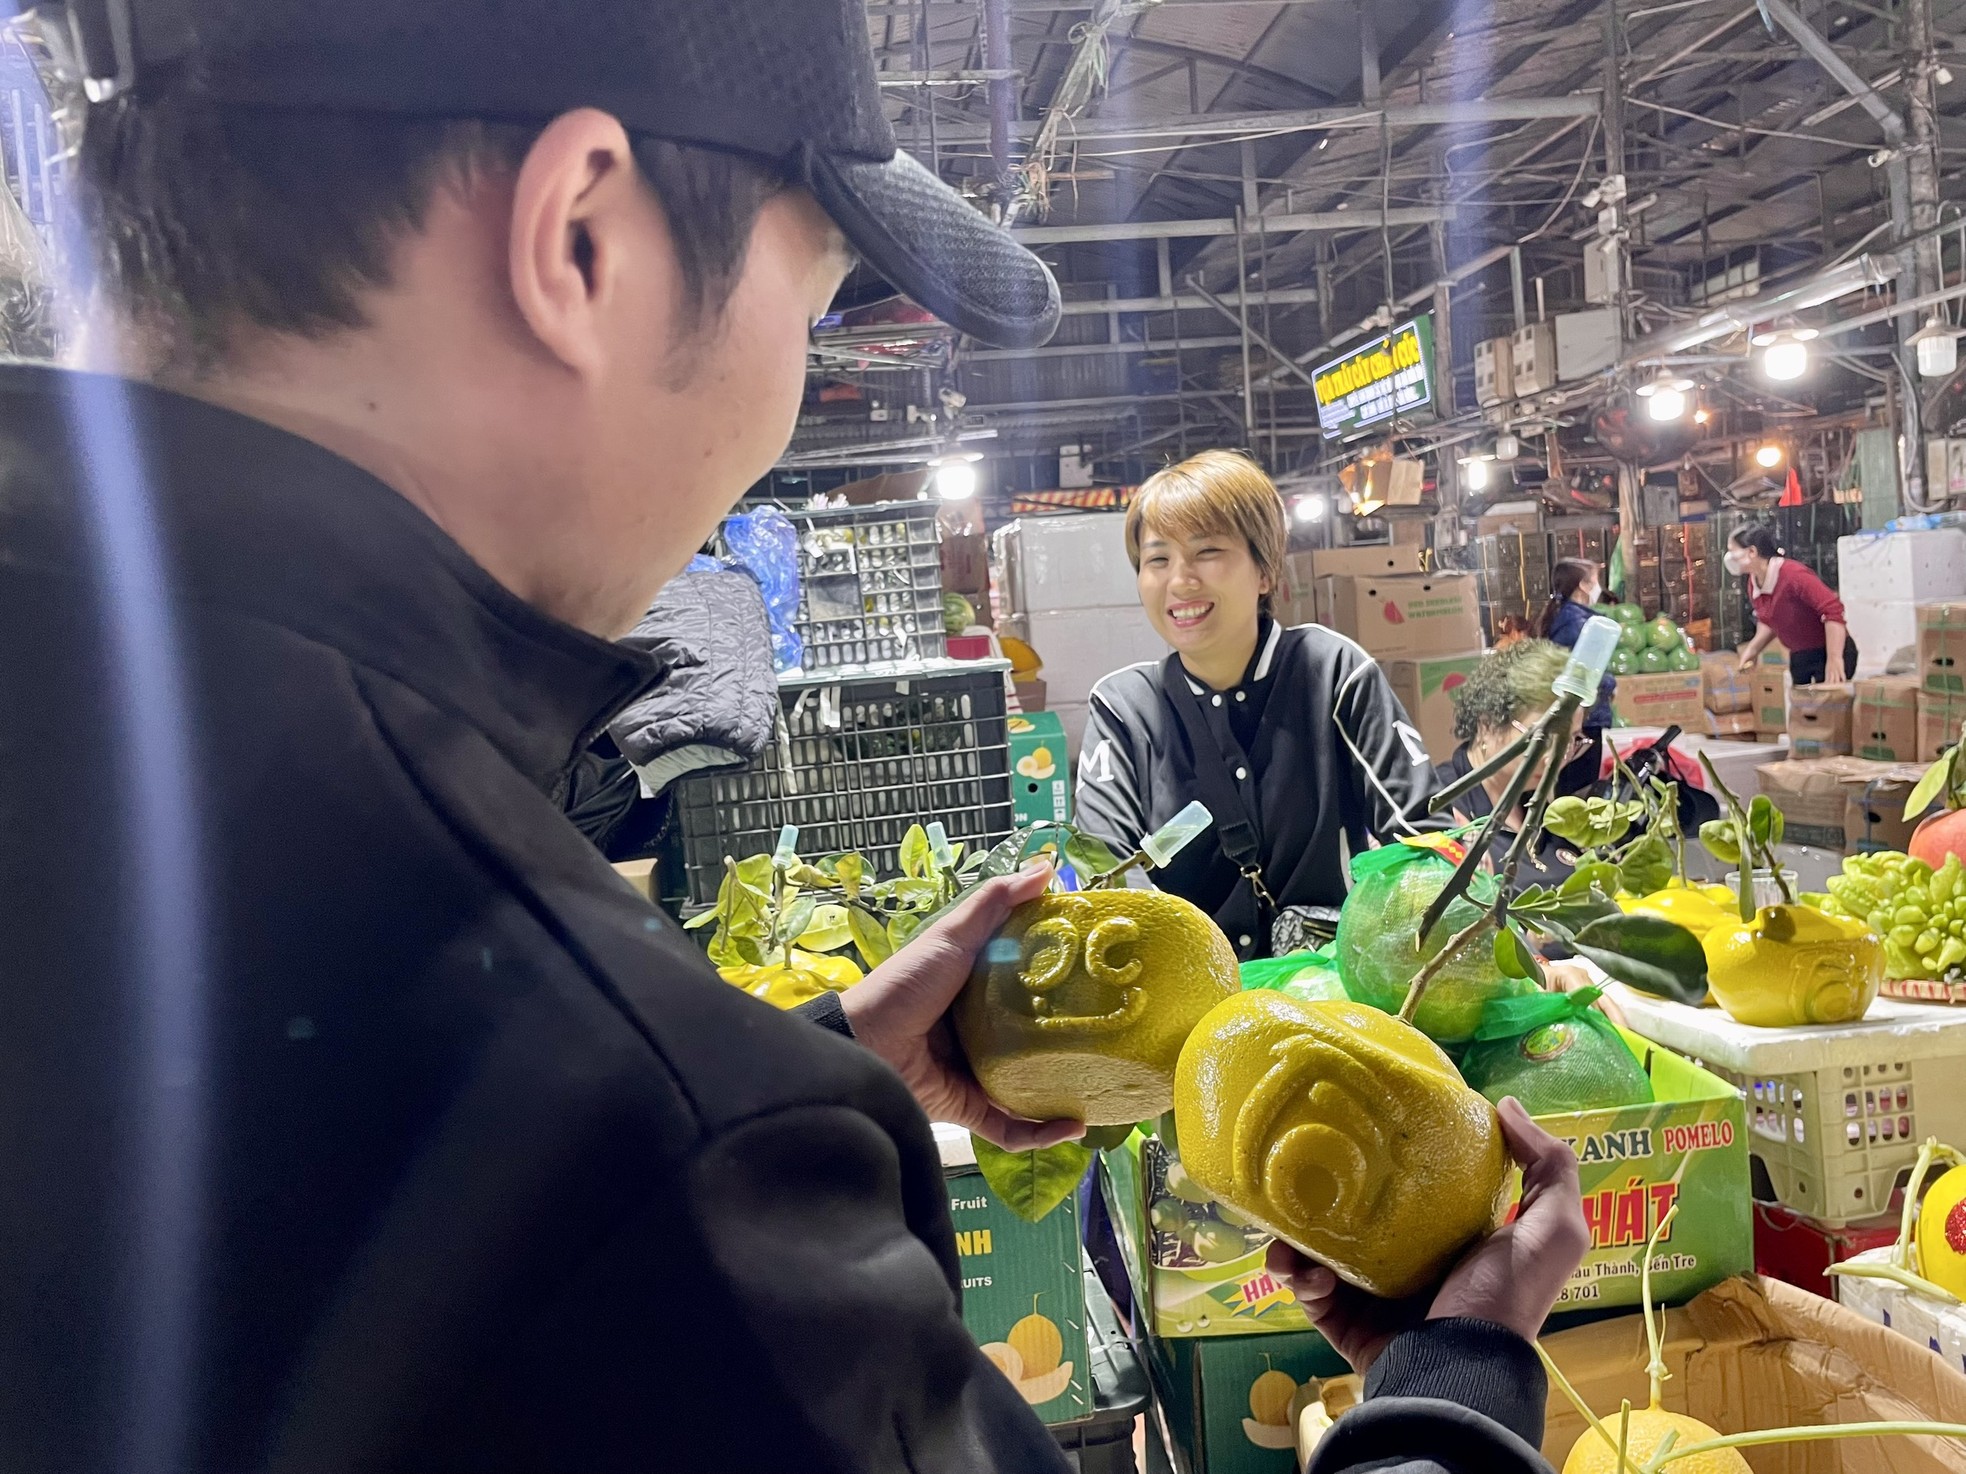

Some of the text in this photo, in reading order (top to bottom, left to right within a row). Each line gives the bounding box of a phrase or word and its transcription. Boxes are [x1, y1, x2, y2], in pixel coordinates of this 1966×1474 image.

[1663, 1121, 1733, 1153] POMELO
[951, 1196, 988, 1211] Fruit
[1581, 1176, 1678, 1247] HÁT
[1595, 1261, 1639, 1277] Thành,
[1646, 1255, 1669, 1271] ến
[1673, 1255, 1695, 1269] Tre
[961, 1276, 993, 1289] UITS
[1243, 1272, 1283, 1303] HÀ
[1574, 1285, 1599, 1300] 701
